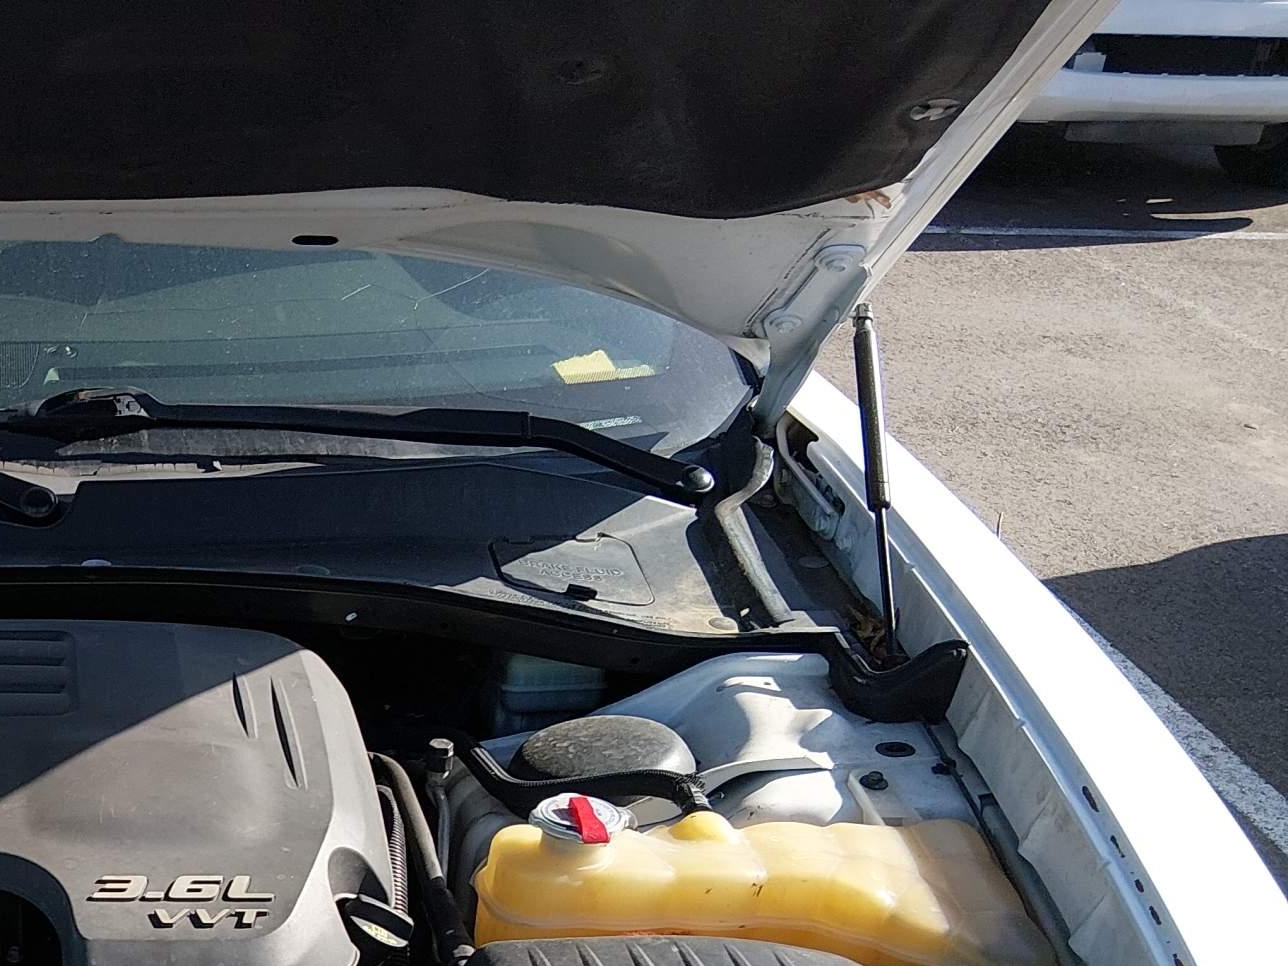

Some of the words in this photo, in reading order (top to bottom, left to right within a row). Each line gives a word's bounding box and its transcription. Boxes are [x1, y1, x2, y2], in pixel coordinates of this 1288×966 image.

[540, 569, 602, 582] ACCESS
[576, 566, 624, 577] FLUID
[86, 875, 275, 902] 3.6L
[147, 908, 269, 929] VVT
